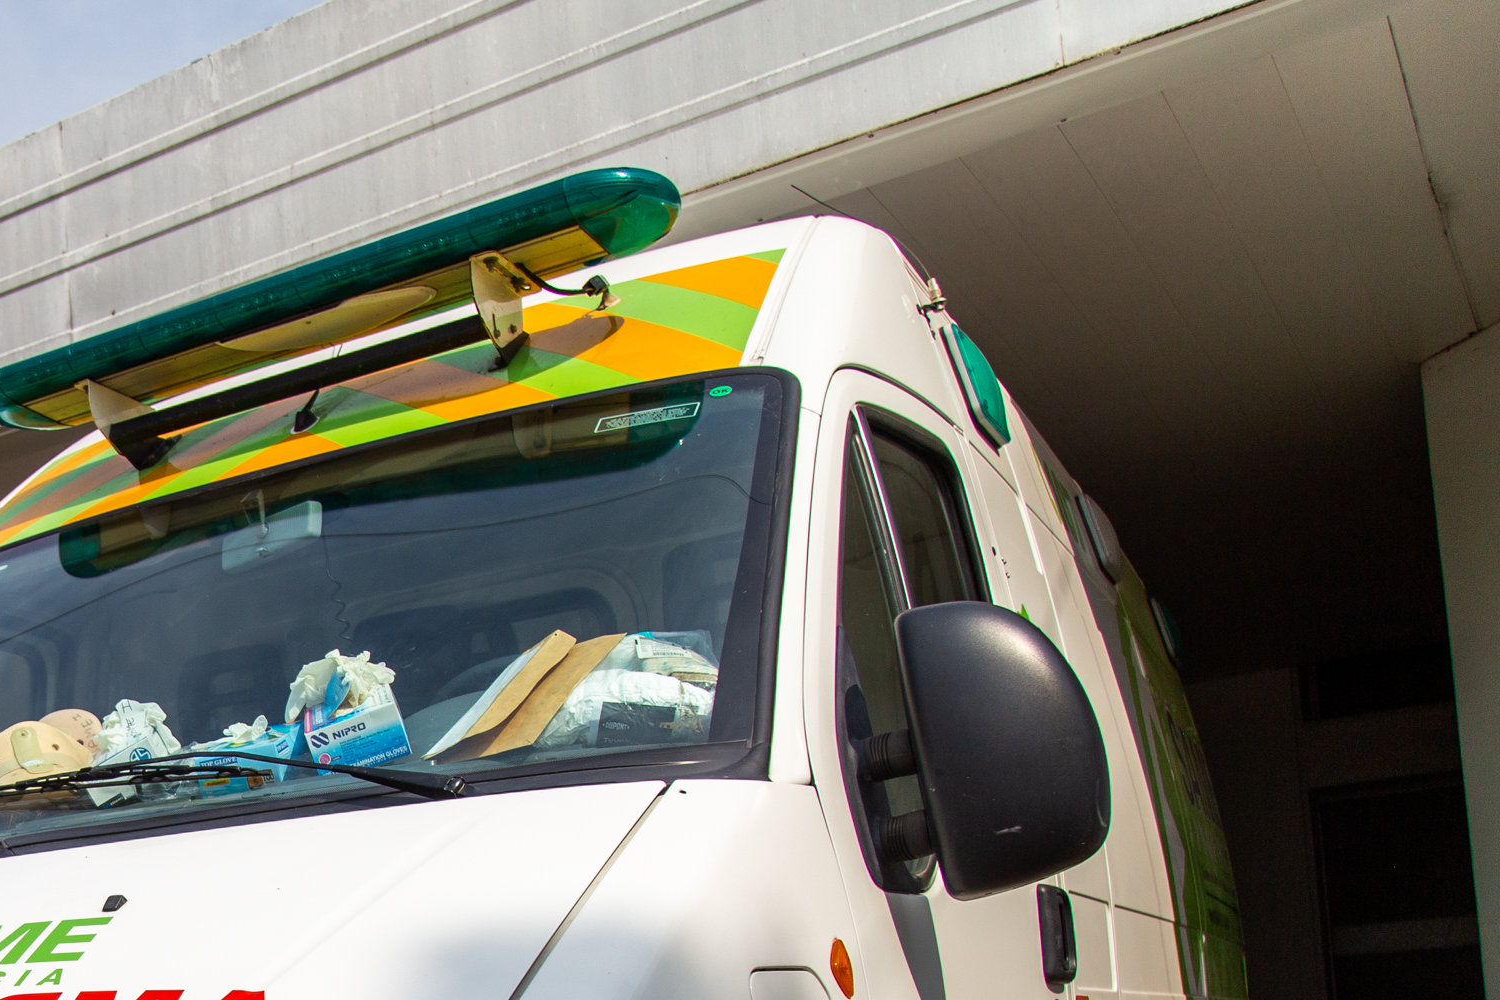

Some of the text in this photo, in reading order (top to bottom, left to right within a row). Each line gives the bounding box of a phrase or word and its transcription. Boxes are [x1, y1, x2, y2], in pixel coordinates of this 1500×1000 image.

[711, 387, 730, 396] OK
[331, 722, 367, 740] NIPRO
[385, 744, 408, 757] GLOVES
[214, 756, 237, 766] GLOVE
